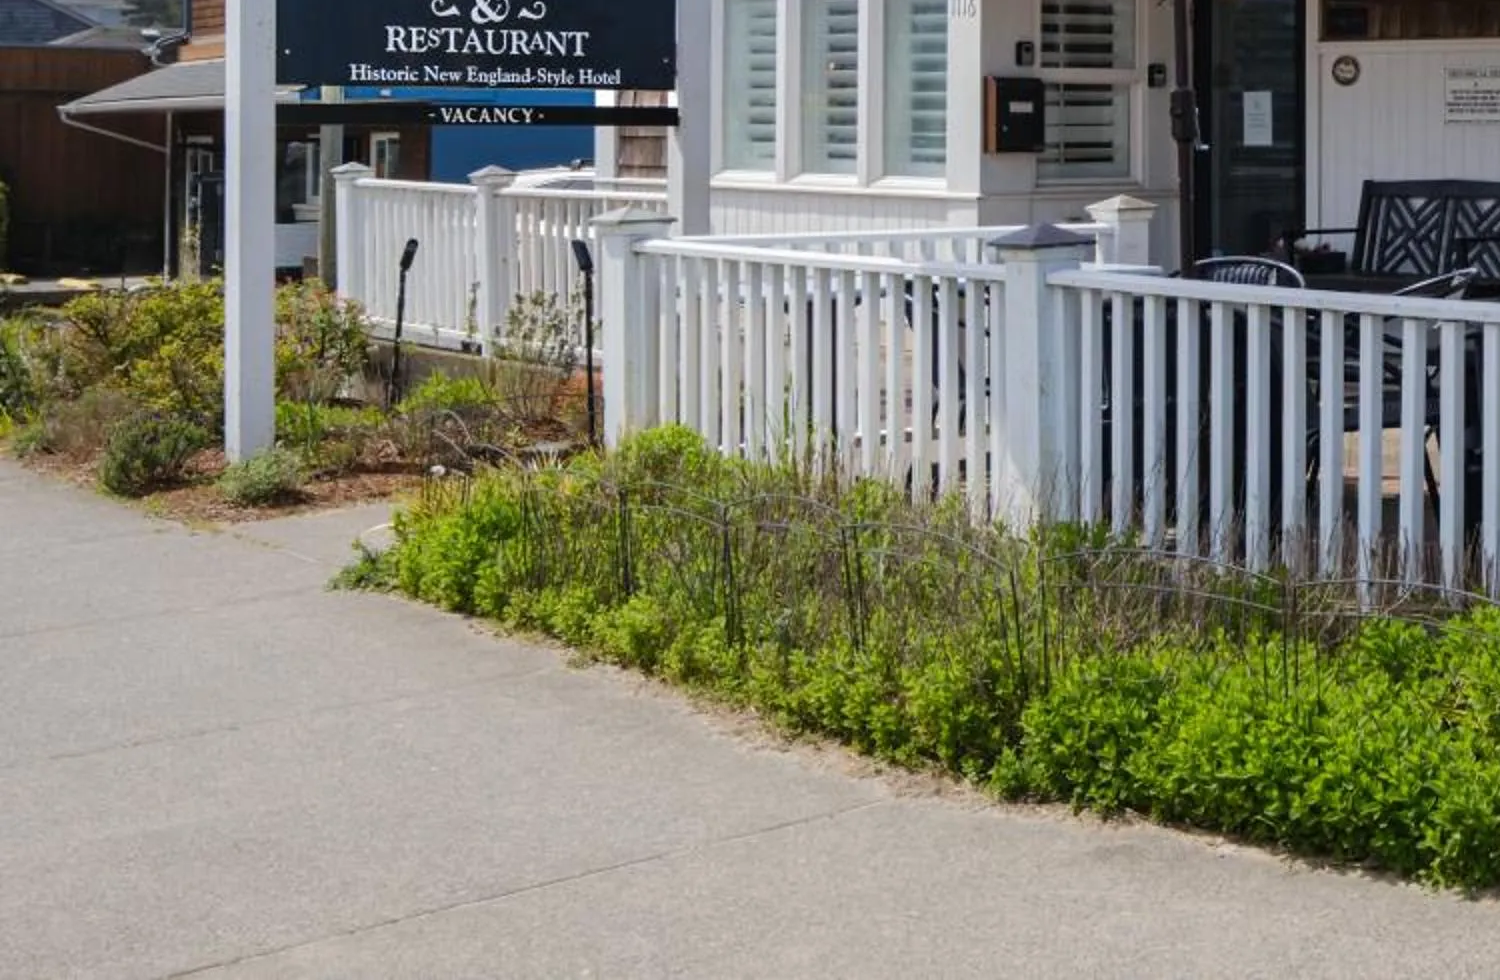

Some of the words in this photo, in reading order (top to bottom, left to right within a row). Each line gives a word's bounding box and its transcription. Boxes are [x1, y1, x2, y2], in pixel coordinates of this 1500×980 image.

[385, 25, 589, 57] RESTAURANT
[350, 63, 419, 83] Historic
[424, 65, 461, 83] New
[466, 66, 575, 87] England-Style
[578, 69, 622, 86] Hotel
[440, 107, 534, 124] VACANCY
